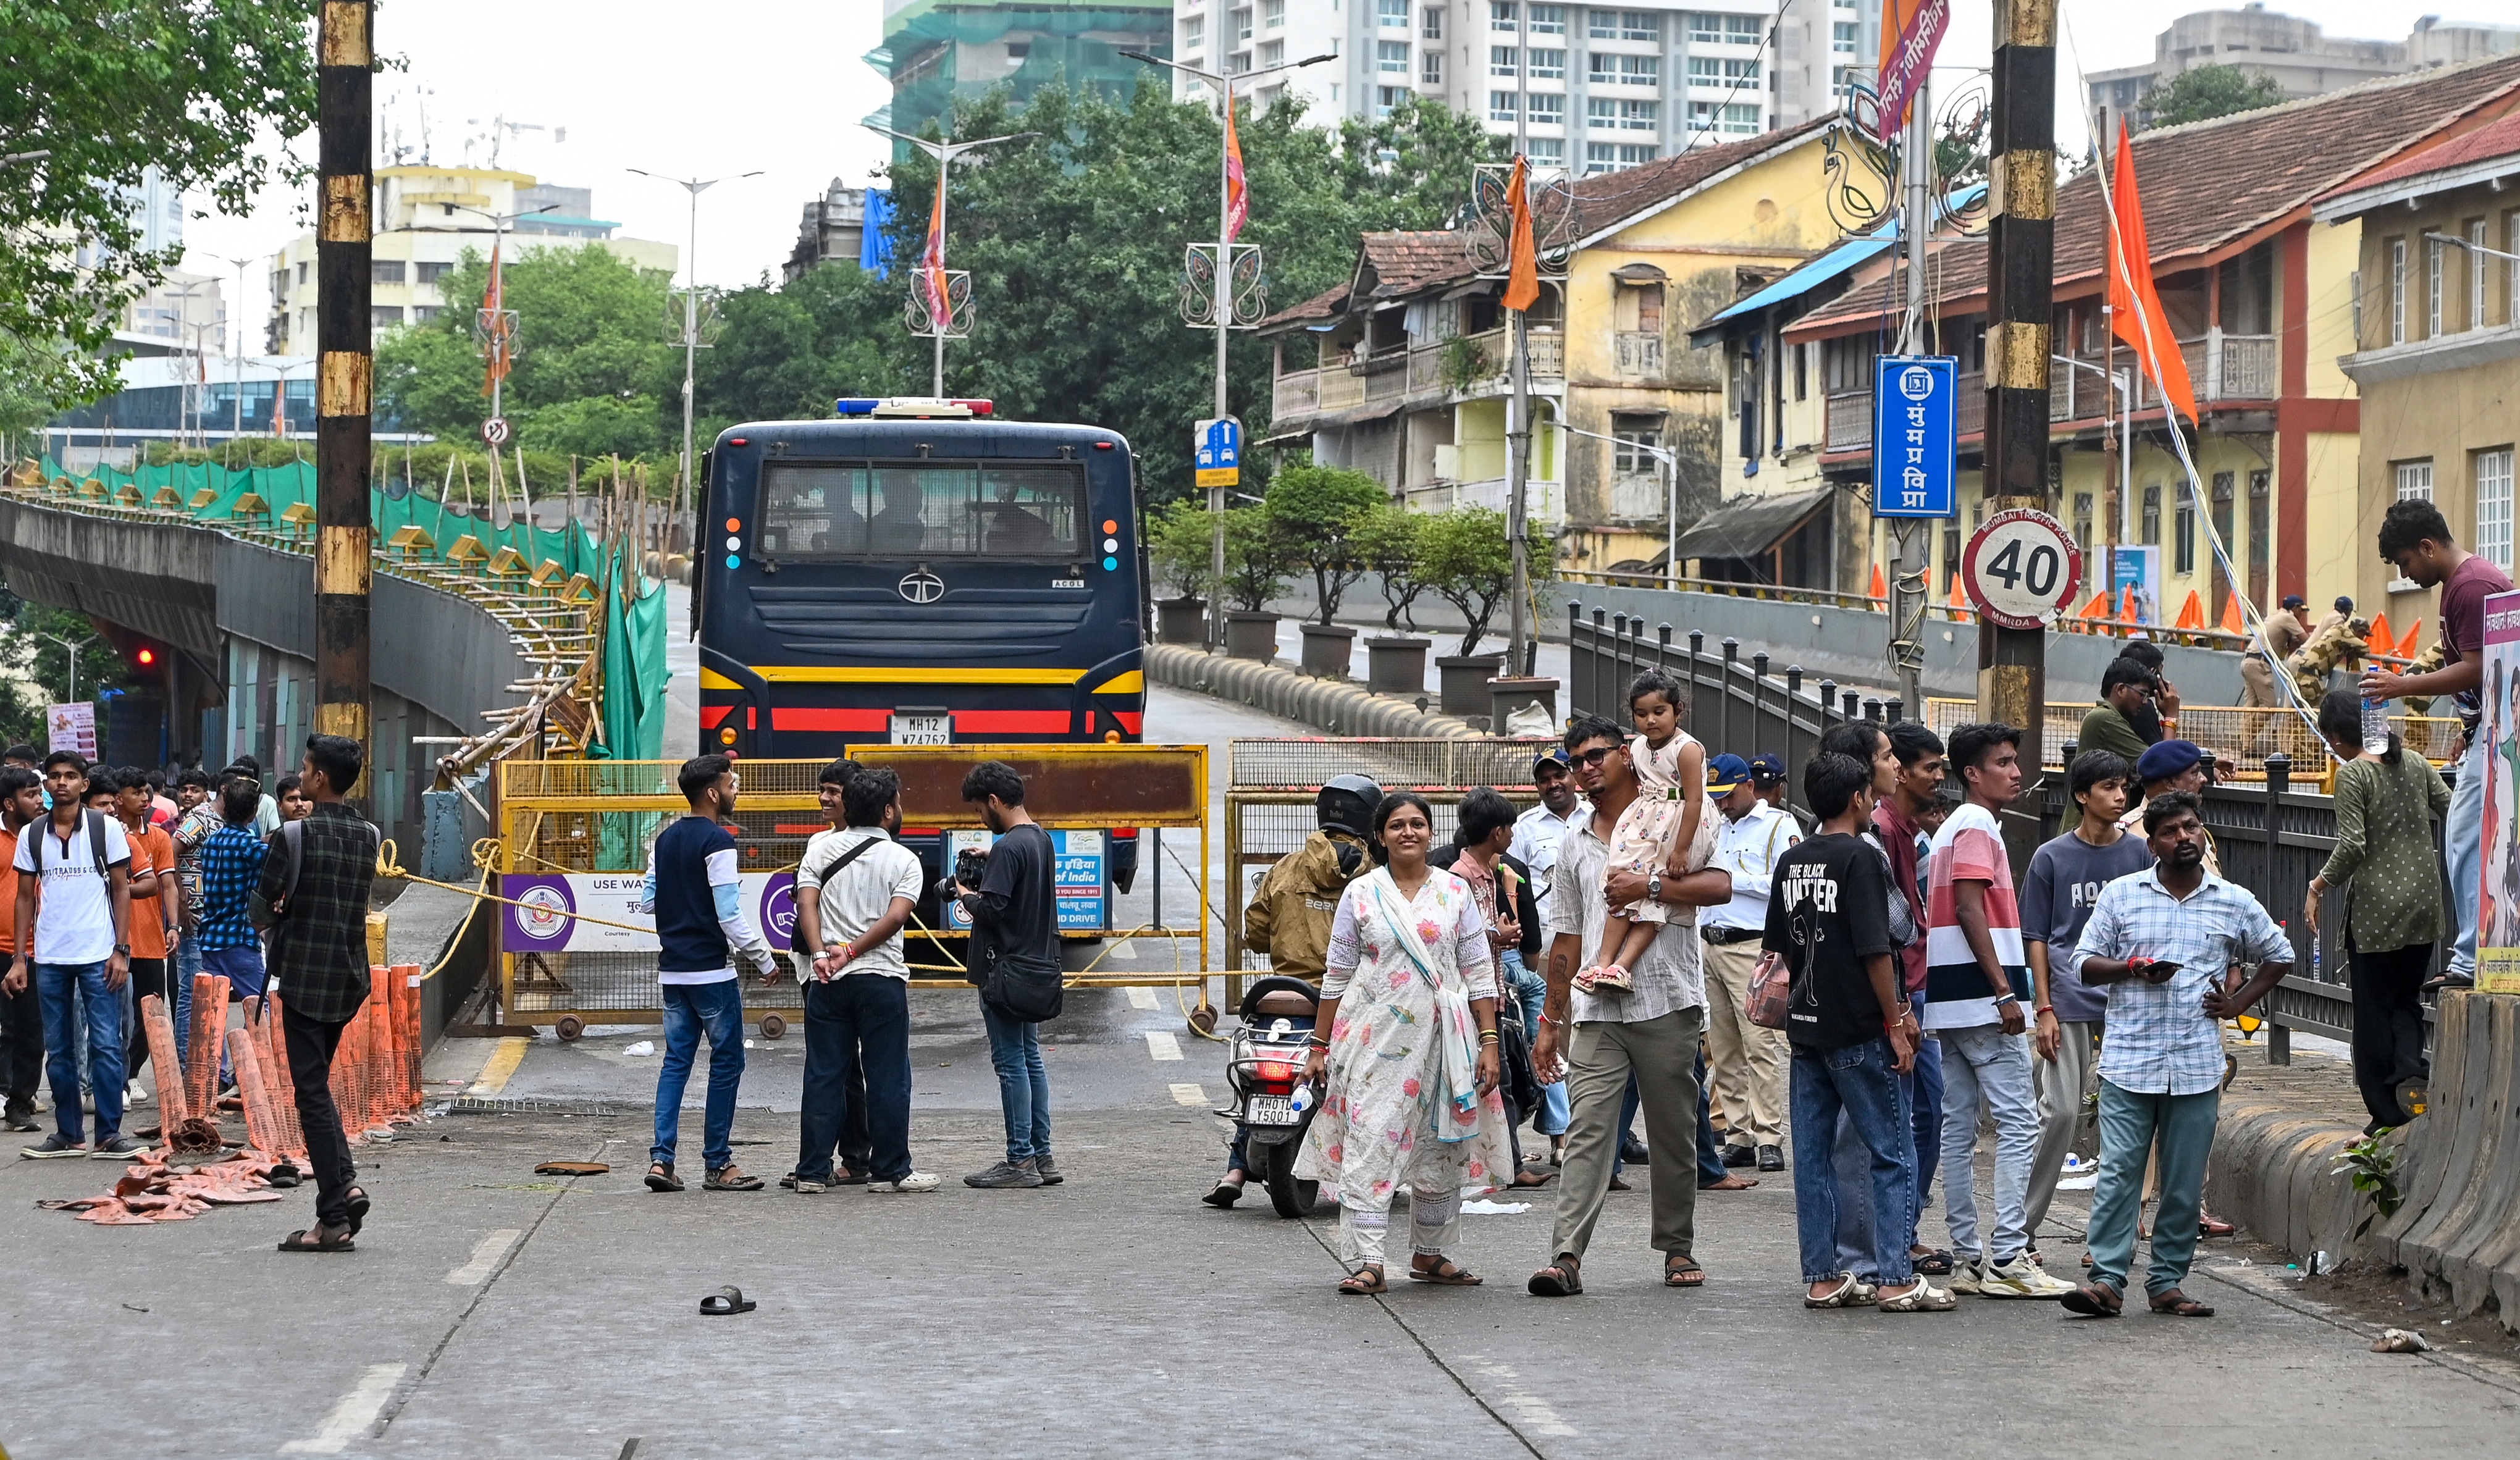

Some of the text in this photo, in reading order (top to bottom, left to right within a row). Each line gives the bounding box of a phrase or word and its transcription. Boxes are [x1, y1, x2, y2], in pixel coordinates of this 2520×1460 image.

[1982, 511, 2077, 556] MUMBAI TRAFFIC POLICE
[1986, 539, 2059, 596] 40
[1991, 610, 2030, 626] MMRDA
[909, 718, 938, 731] MH12
[902, 734, 946, 745] WZ4762
[1065, 858, 1095, 870] इंडिया
[1069, 871, 1096, 882] India
[1789, 863, 1827, 878] THE BLACK
[594, 879, 618, 889] USE
[1782, 878, 1838, 913] PANTHER
[1258, 1099, 1292, 1110] MH01D
[1258, 1110, 1290, 1122] Y5001
